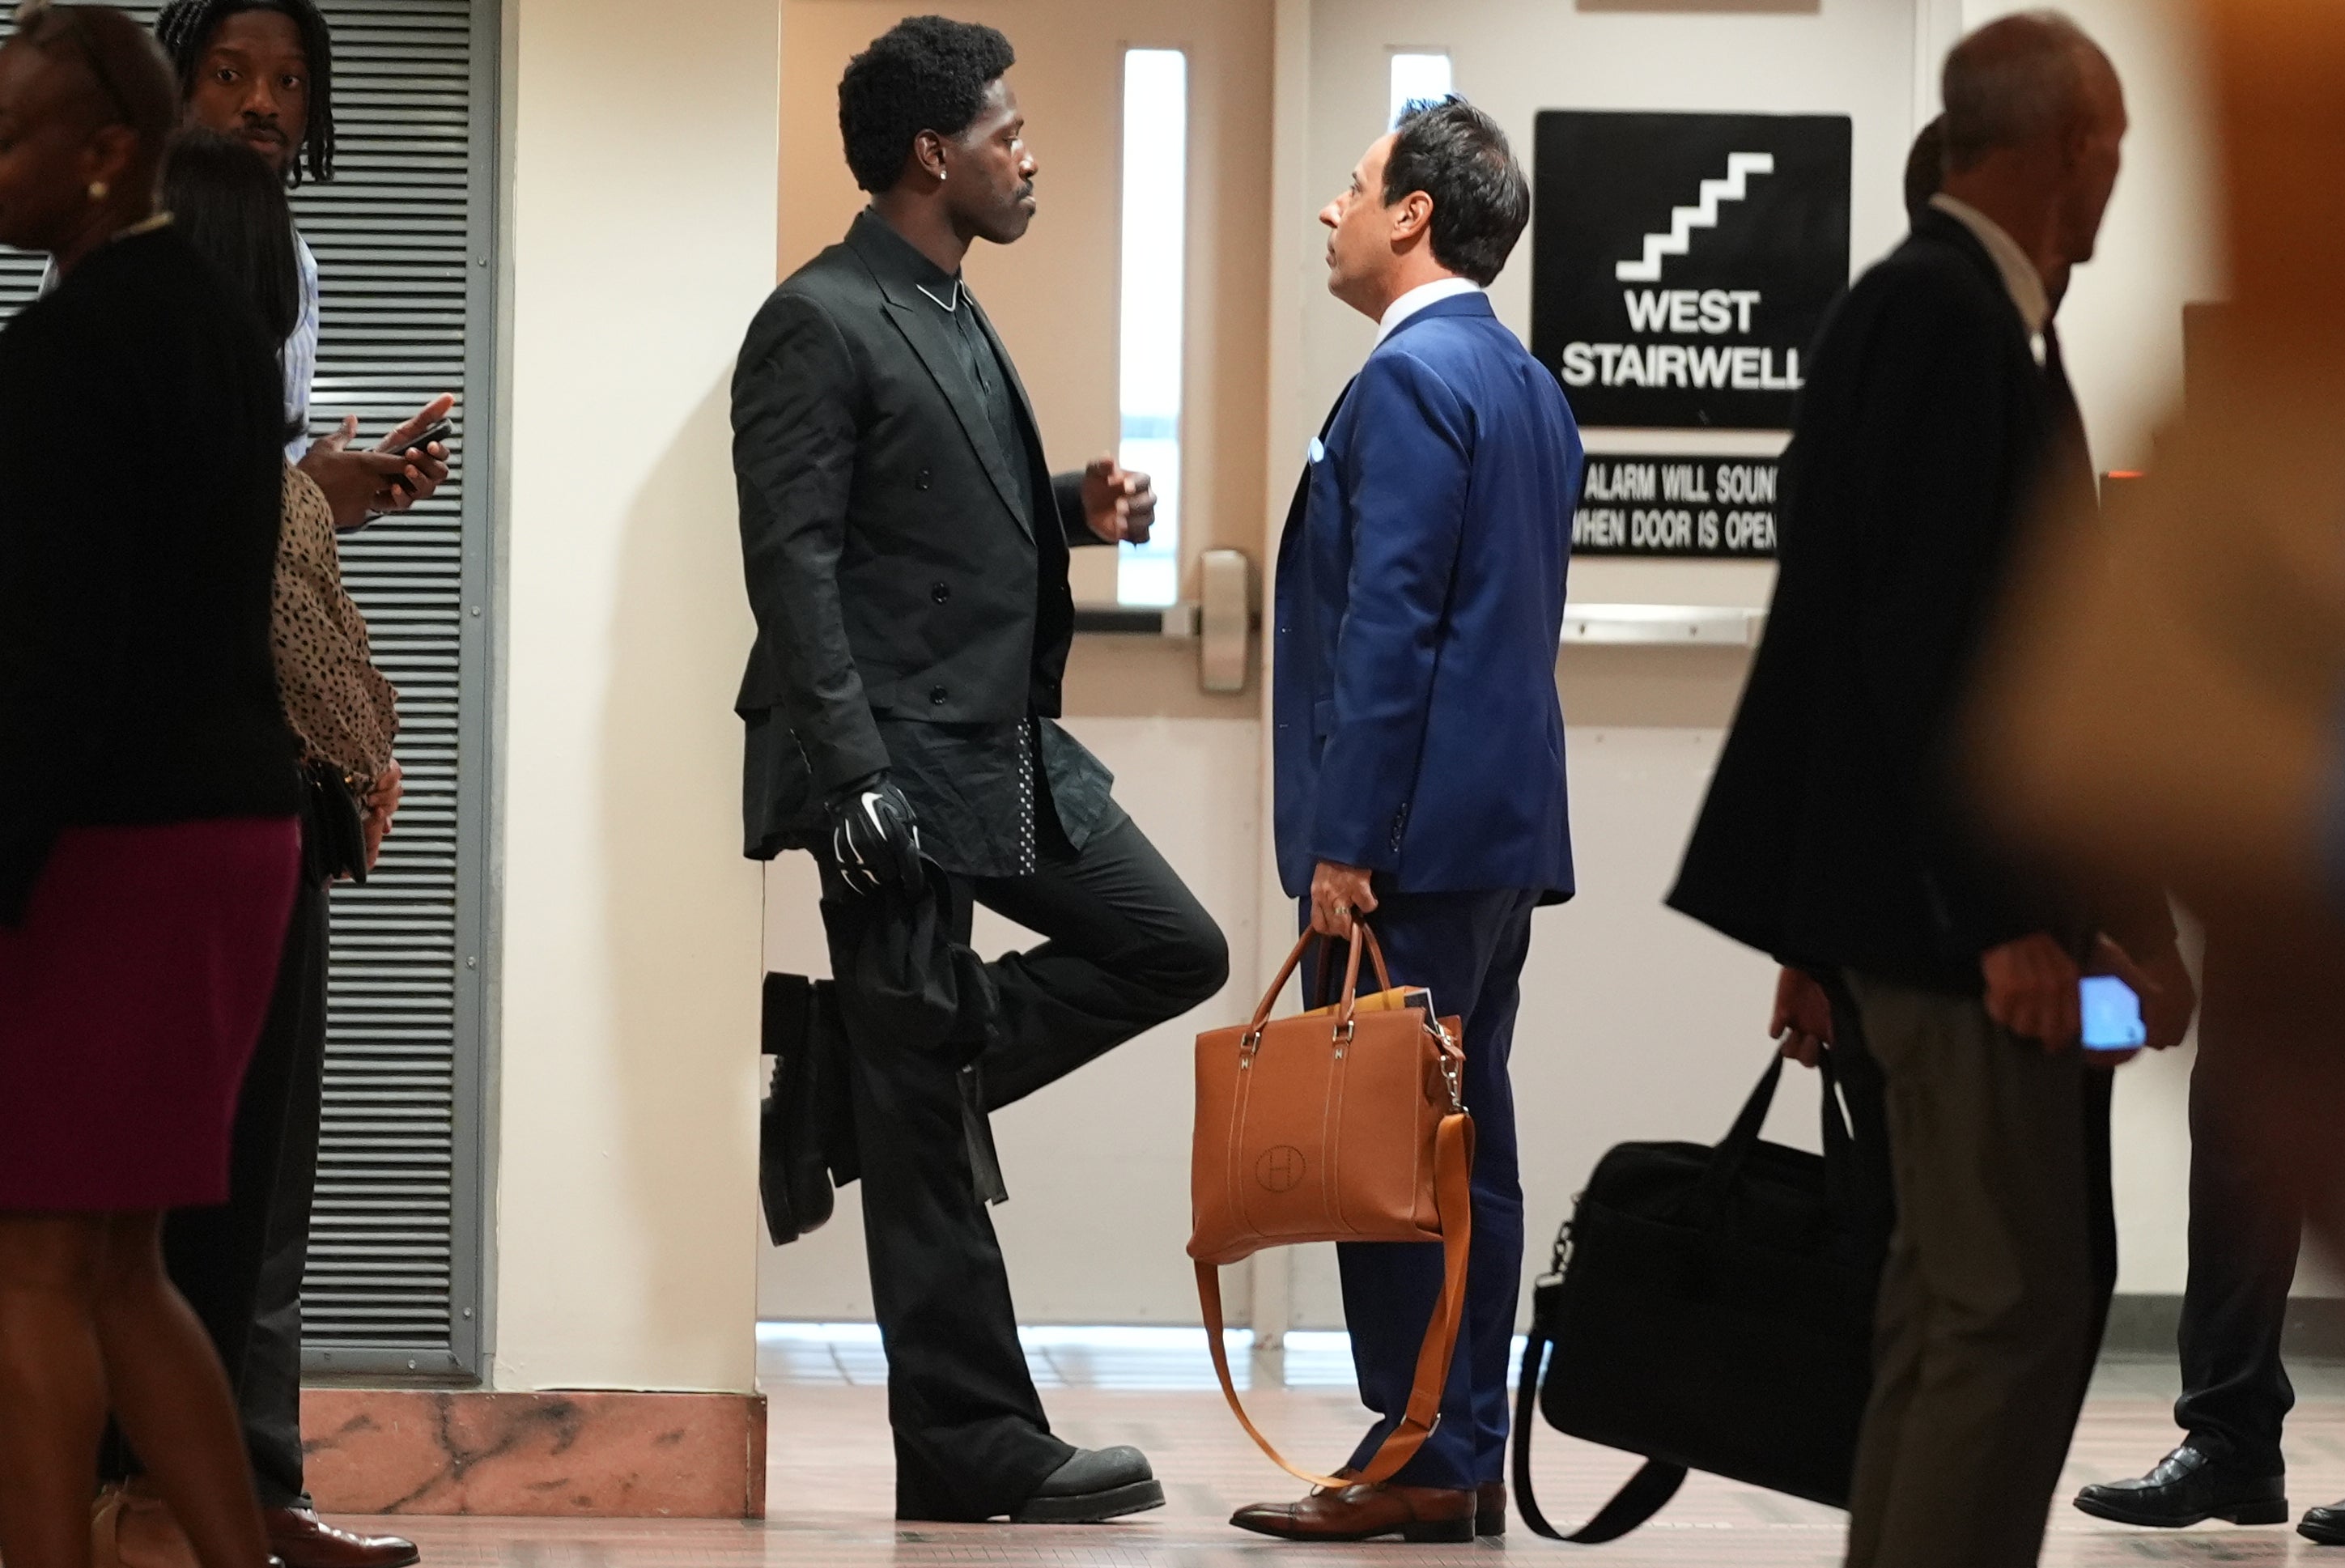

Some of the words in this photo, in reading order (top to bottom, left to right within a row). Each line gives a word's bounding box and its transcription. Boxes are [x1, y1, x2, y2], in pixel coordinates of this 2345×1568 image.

[1623, 289, 1761, 334] WEST
[1561, 341, 1806, 390] STAIRWELL
[1583, 462, 1656, 503] ALARM
[1660, 463, 1710, 504] WILL
[1630, 508, 1692, 550] DOOR
[1697, 508, 1719, 550] IS
